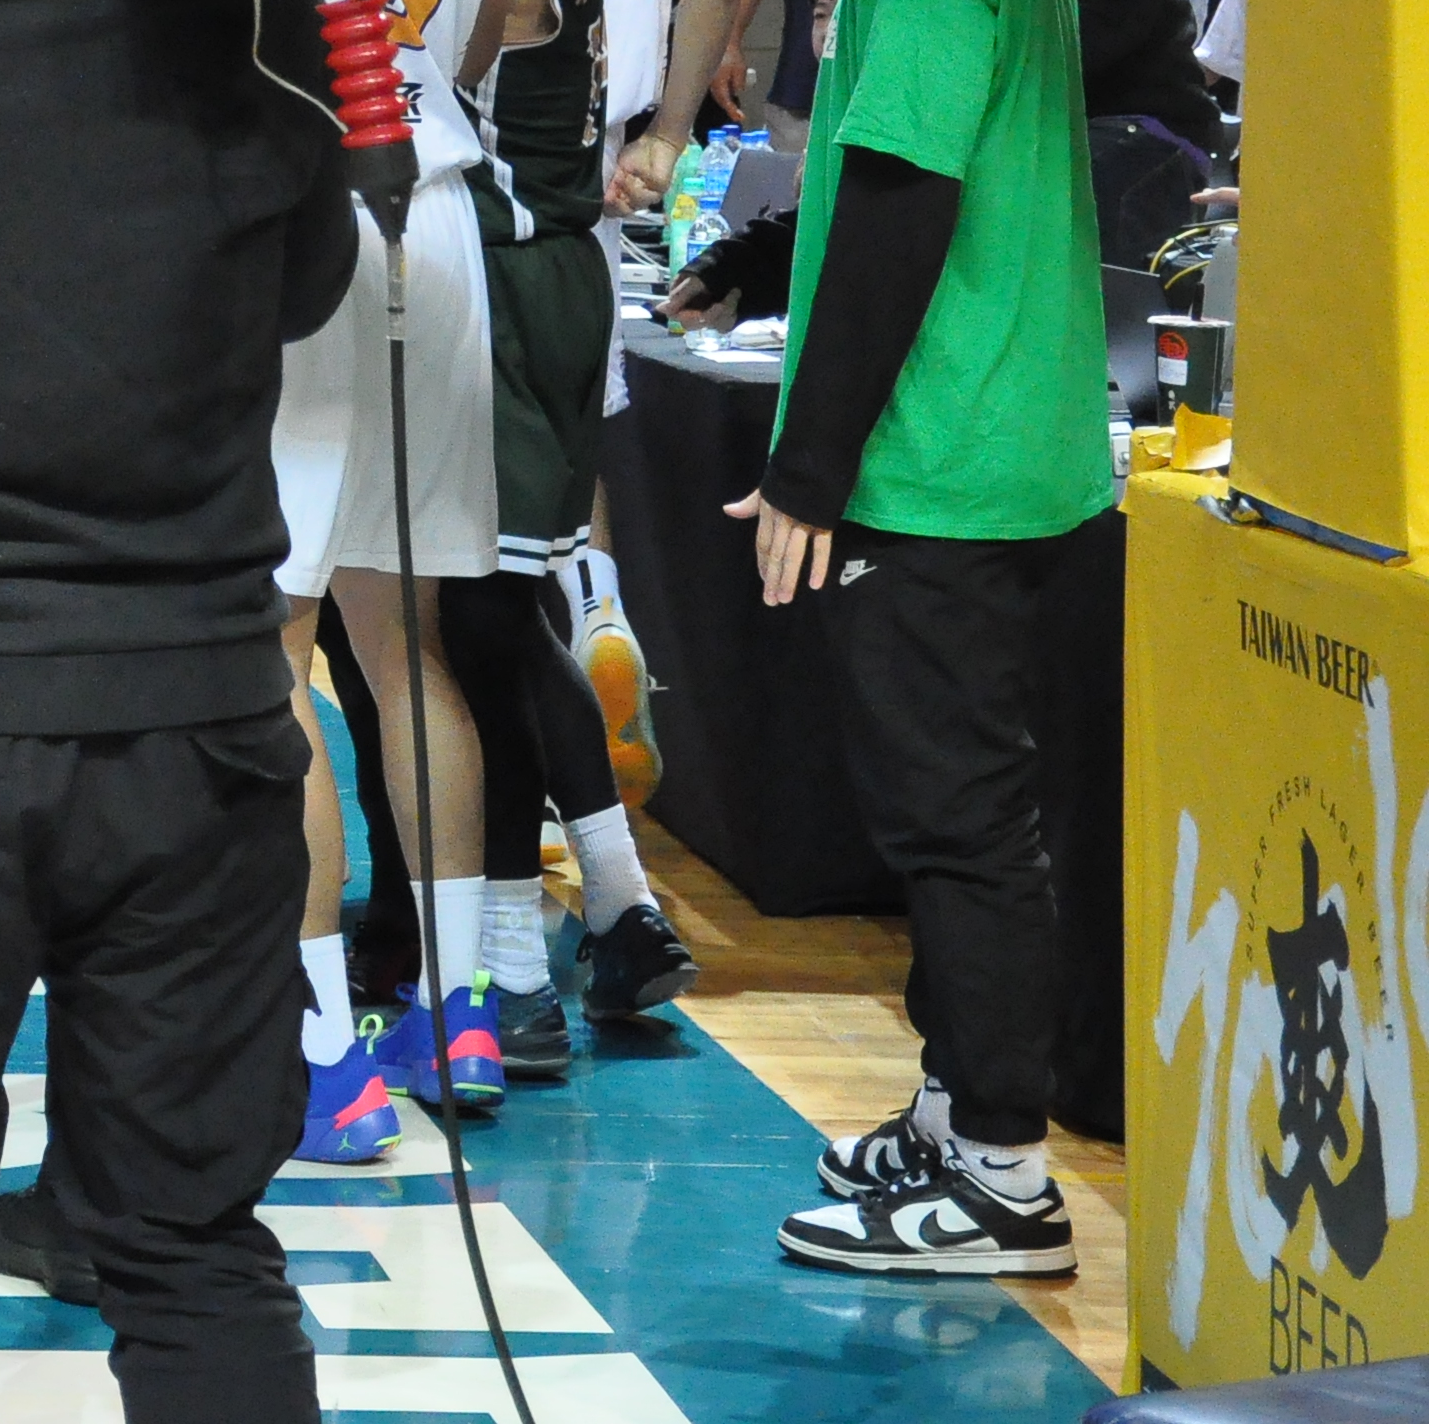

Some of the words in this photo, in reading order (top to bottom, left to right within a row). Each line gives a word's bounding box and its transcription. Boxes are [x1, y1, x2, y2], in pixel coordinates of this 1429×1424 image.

[1237, 598, 1311, 681] TAIWAN
[1315, 632, 1376, 709] BEER
[1267, 775, 1312, 828] FRESH
